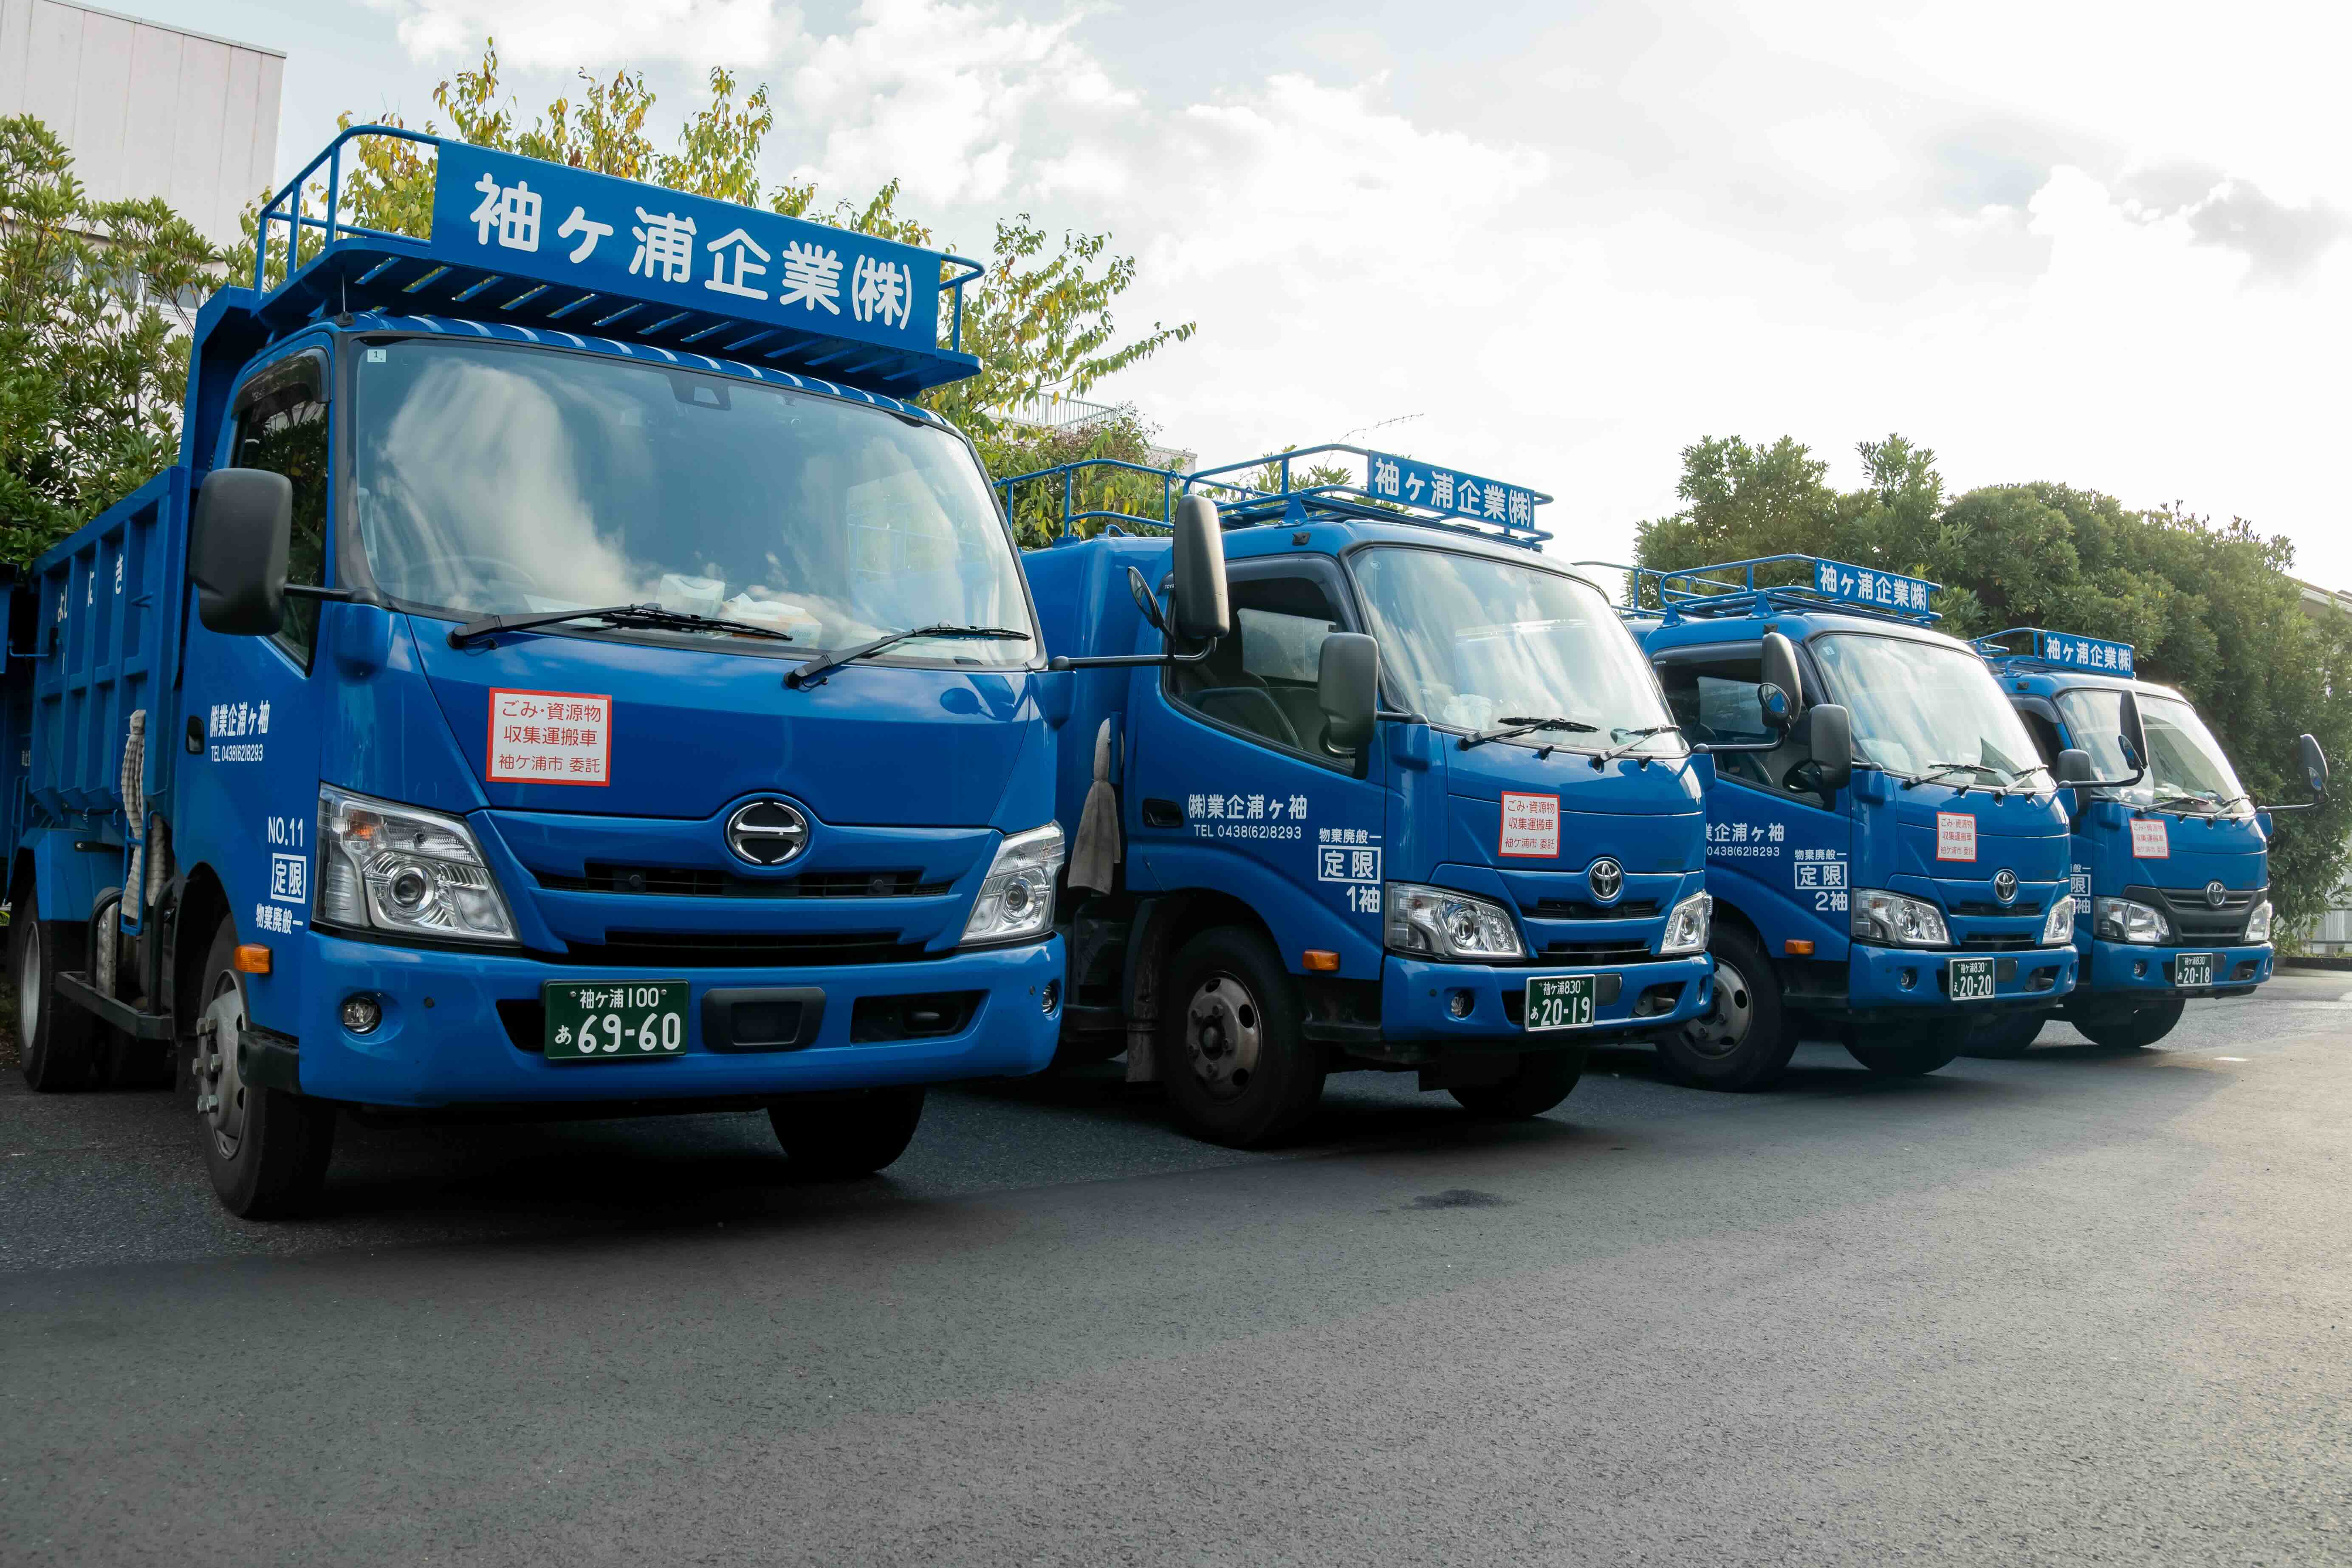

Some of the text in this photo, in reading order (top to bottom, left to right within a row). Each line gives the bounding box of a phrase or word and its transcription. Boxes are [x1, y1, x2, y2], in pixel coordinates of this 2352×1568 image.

[504, 725, 597, 746] 収集運搬車
[211, 744, 263, 762] TEL 0438(62)8293
[570, 757, 600, 773] 委託
[268, 816, 303, 847] NO.11
[1194, 825, 1302, 839] TEL 0438(62)8293
[1707, 846, 1779, 856] 0438(62)8293
[2183, 966, 2210, 983] 20-18
[1960, 975, 1991, 997] 20-20
[1530, 997, 1590, 1026] あ 20-19
[555, 1012, 680, 1054] あ 69-60
